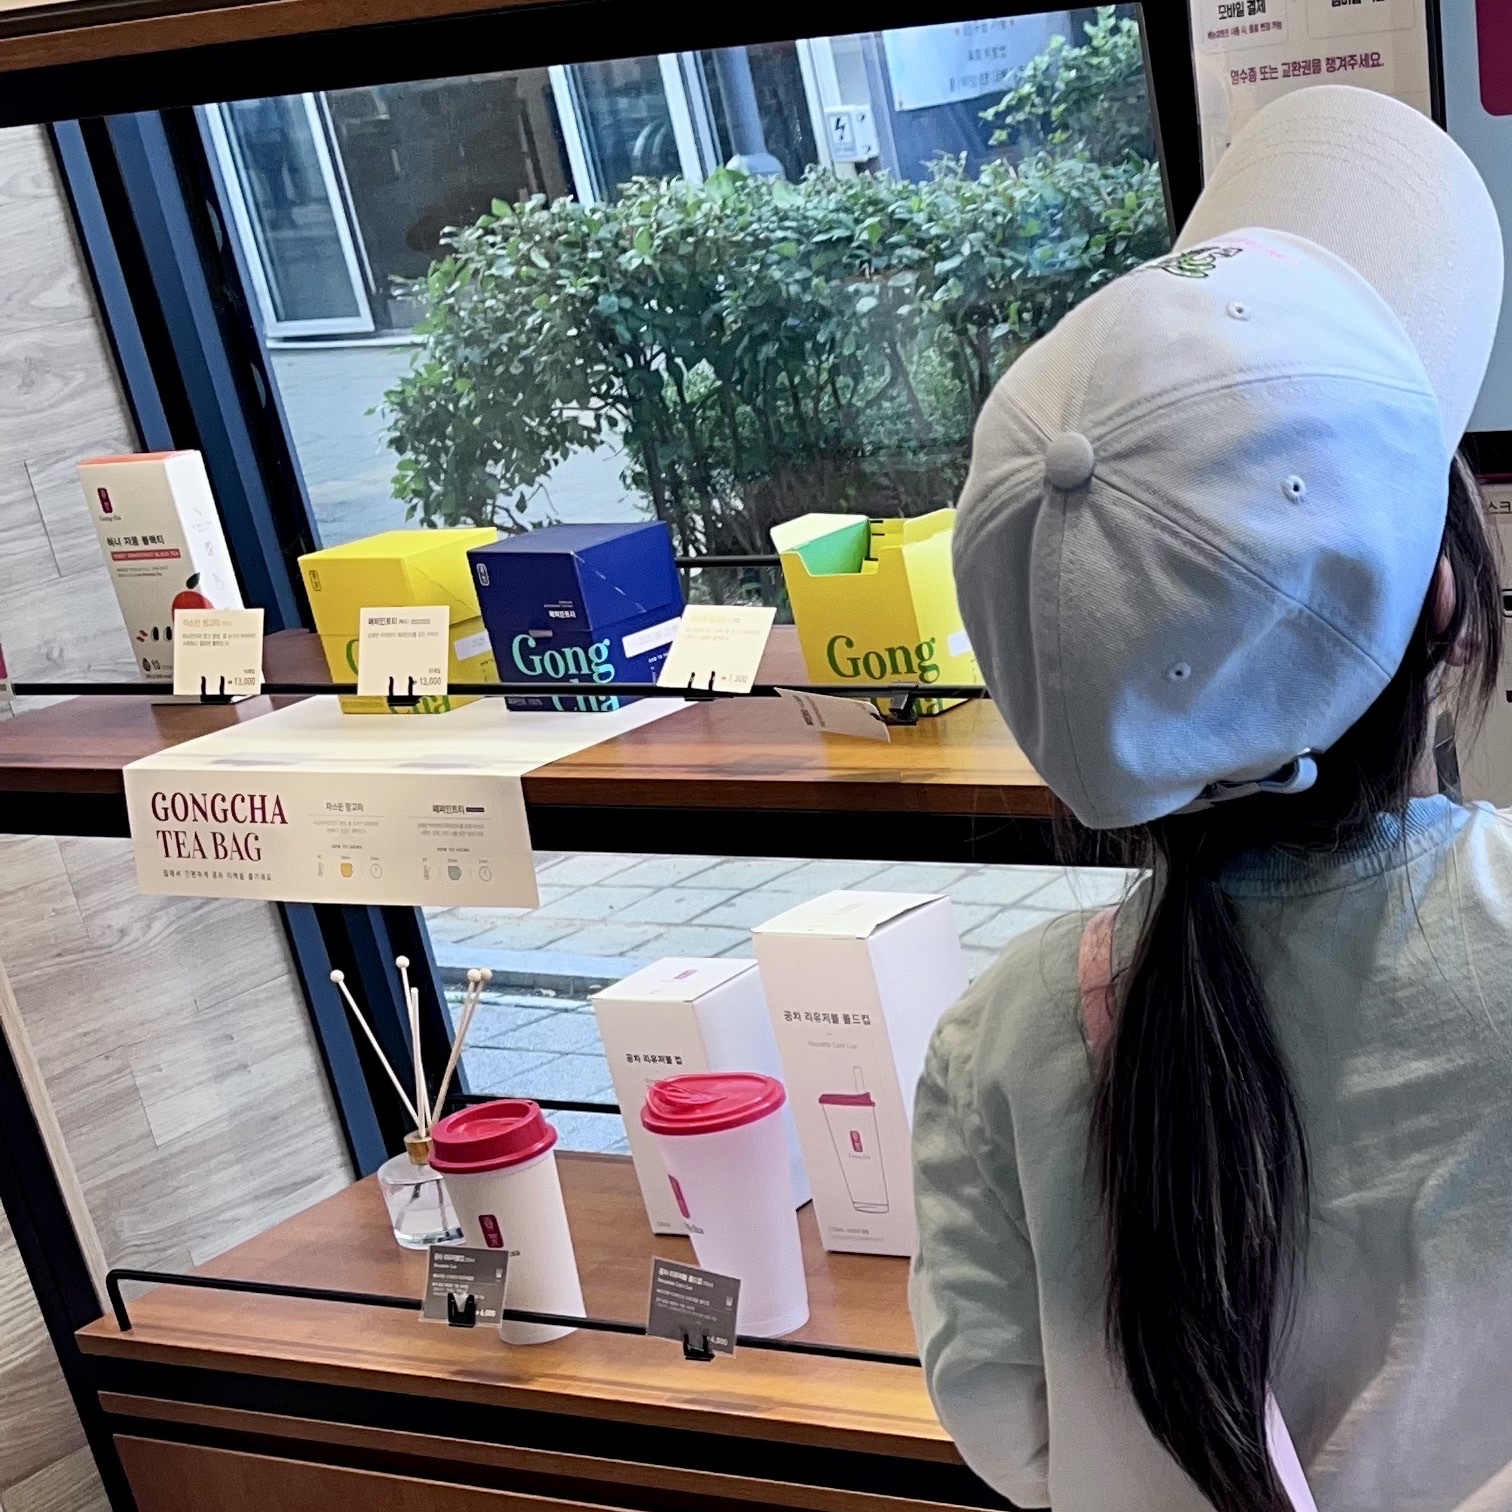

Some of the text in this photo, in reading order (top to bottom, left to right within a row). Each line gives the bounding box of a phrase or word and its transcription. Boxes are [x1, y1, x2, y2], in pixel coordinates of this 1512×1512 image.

[1218, 2, 1245, 20] 모바일
[1230, 52, 1385, 85] 영수증 또는 교환권을 챙겨주세요.
[512, 634, 616, 684] Gong
[826, 634, 940, 684] Gong
[151, 791, 289, 825] GONGCHA
[156, 830, 262, 862] TEA BAG
[783, 1010, 801, 1022] 공차
[803, 1011, 840, 1025] 리유저블
[626, 1053, 641, 1064] 공차
